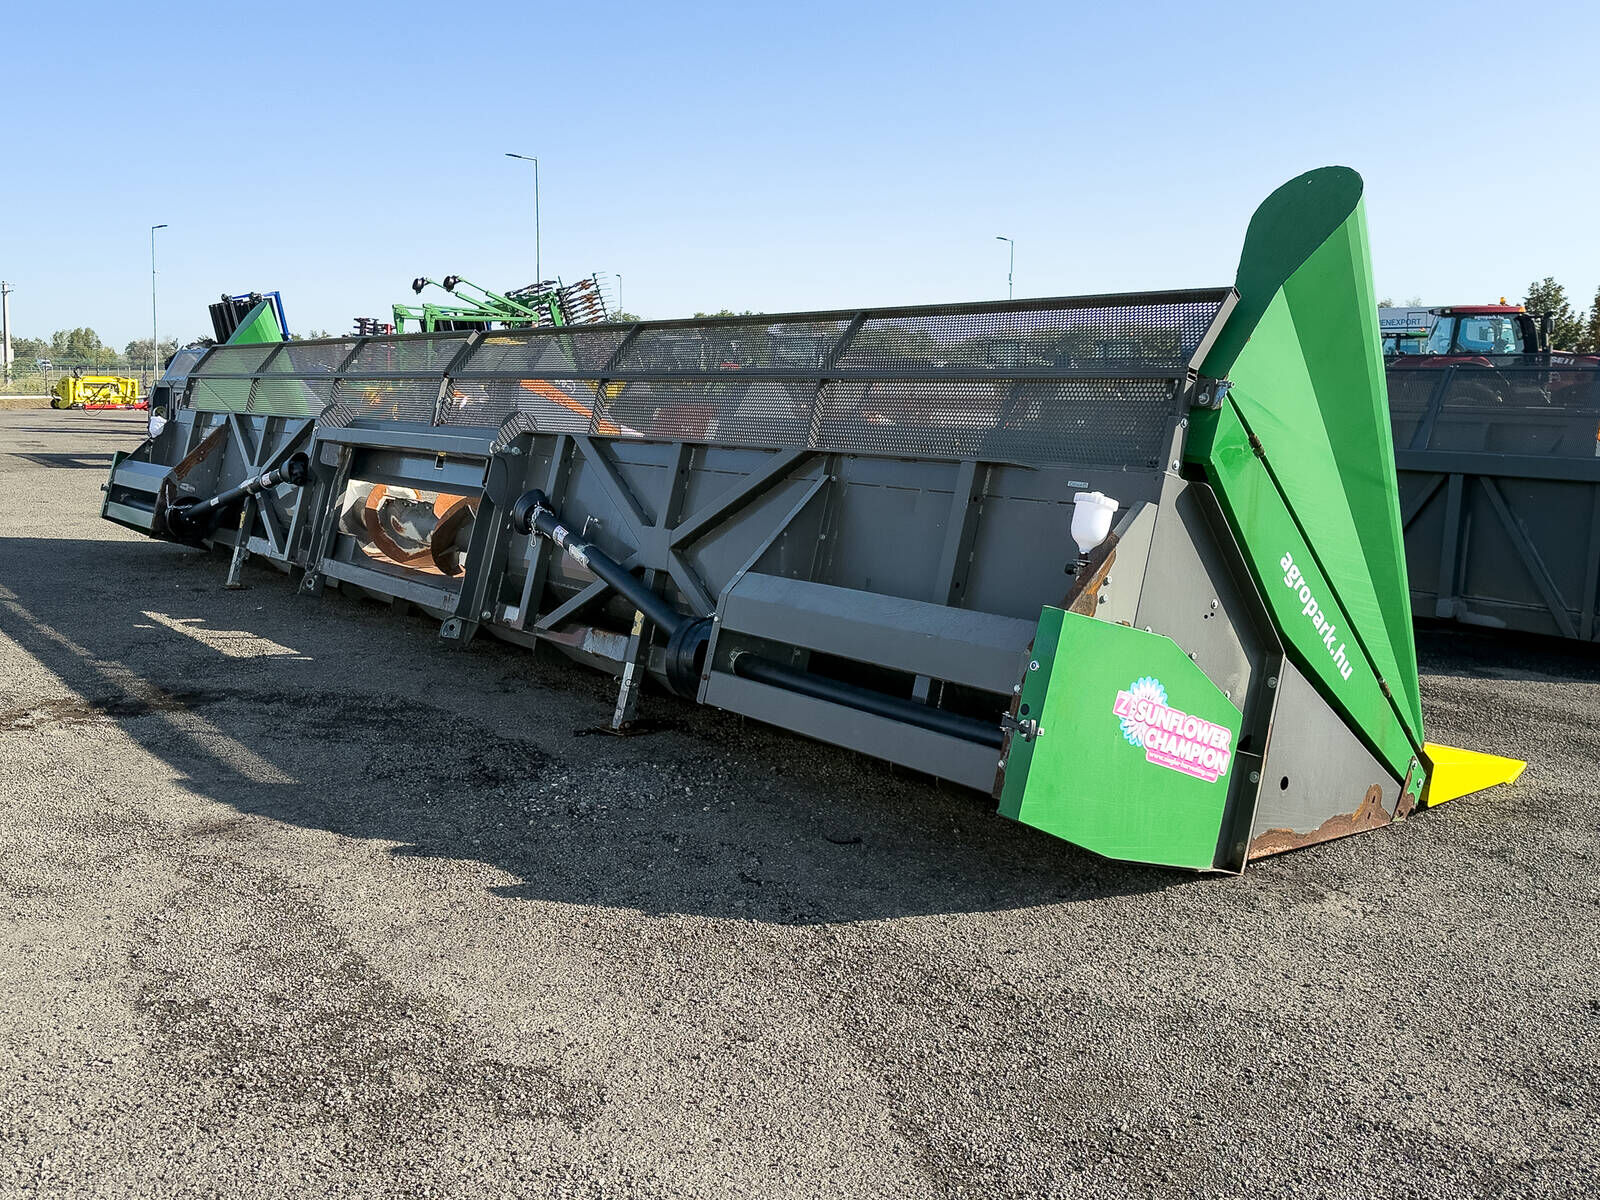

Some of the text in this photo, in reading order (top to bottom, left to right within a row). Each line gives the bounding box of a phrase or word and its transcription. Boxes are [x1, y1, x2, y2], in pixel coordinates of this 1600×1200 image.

[1279, 551, 1354, 681] agropark.hu
[1135, 700, 1230, 750] SUNFLOWER
[1145, 727, 1229, 774] CHAMPION
